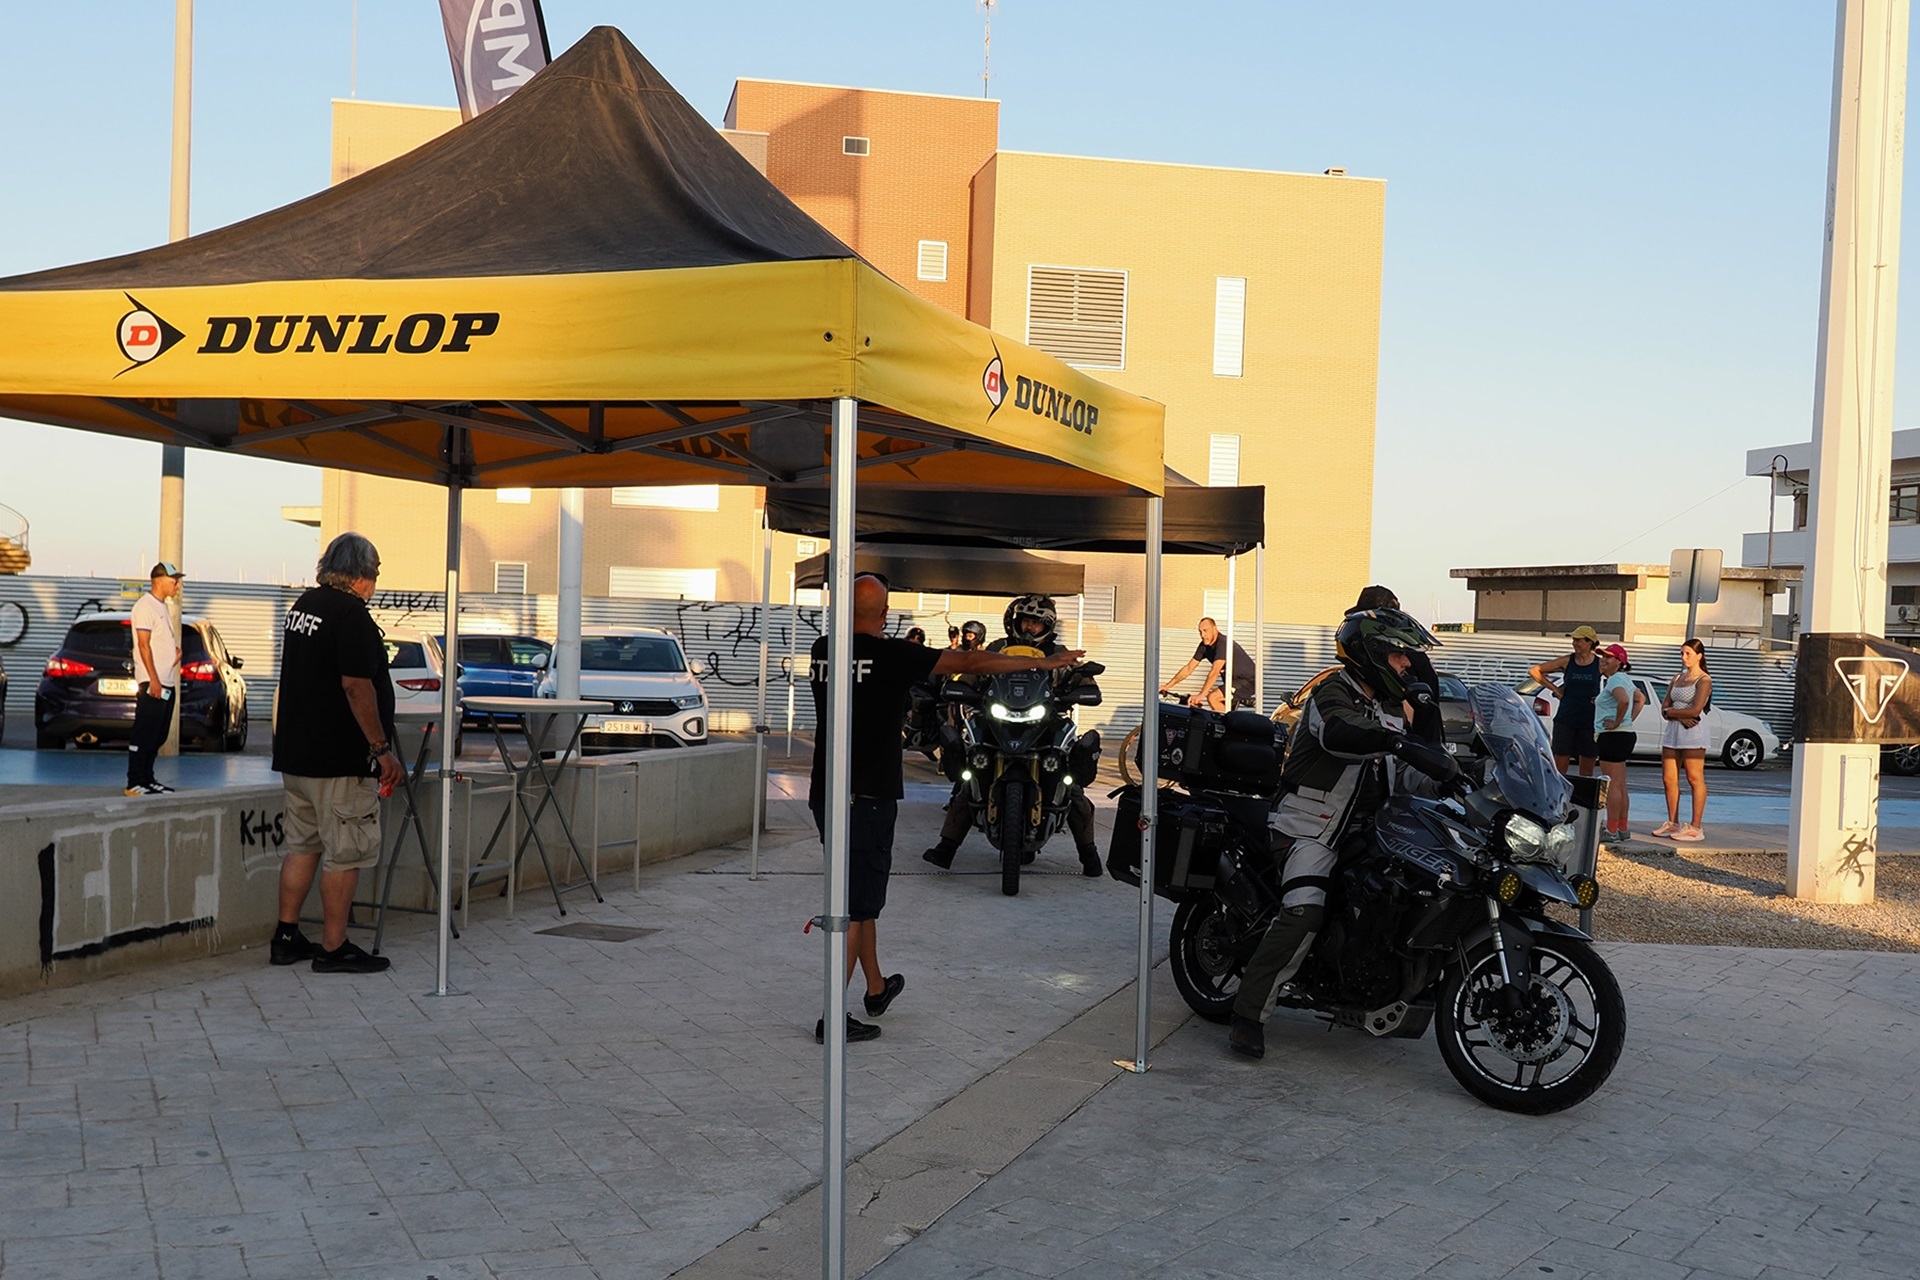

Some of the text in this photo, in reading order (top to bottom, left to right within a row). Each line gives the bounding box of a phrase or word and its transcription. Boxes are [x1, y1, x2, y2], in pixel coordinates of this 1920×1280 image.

[197, 312, 500, 354] DUNLOP
[1014, 374, 1099, 436] DUNLOP
[285, 610, 323, 637] STAFF
